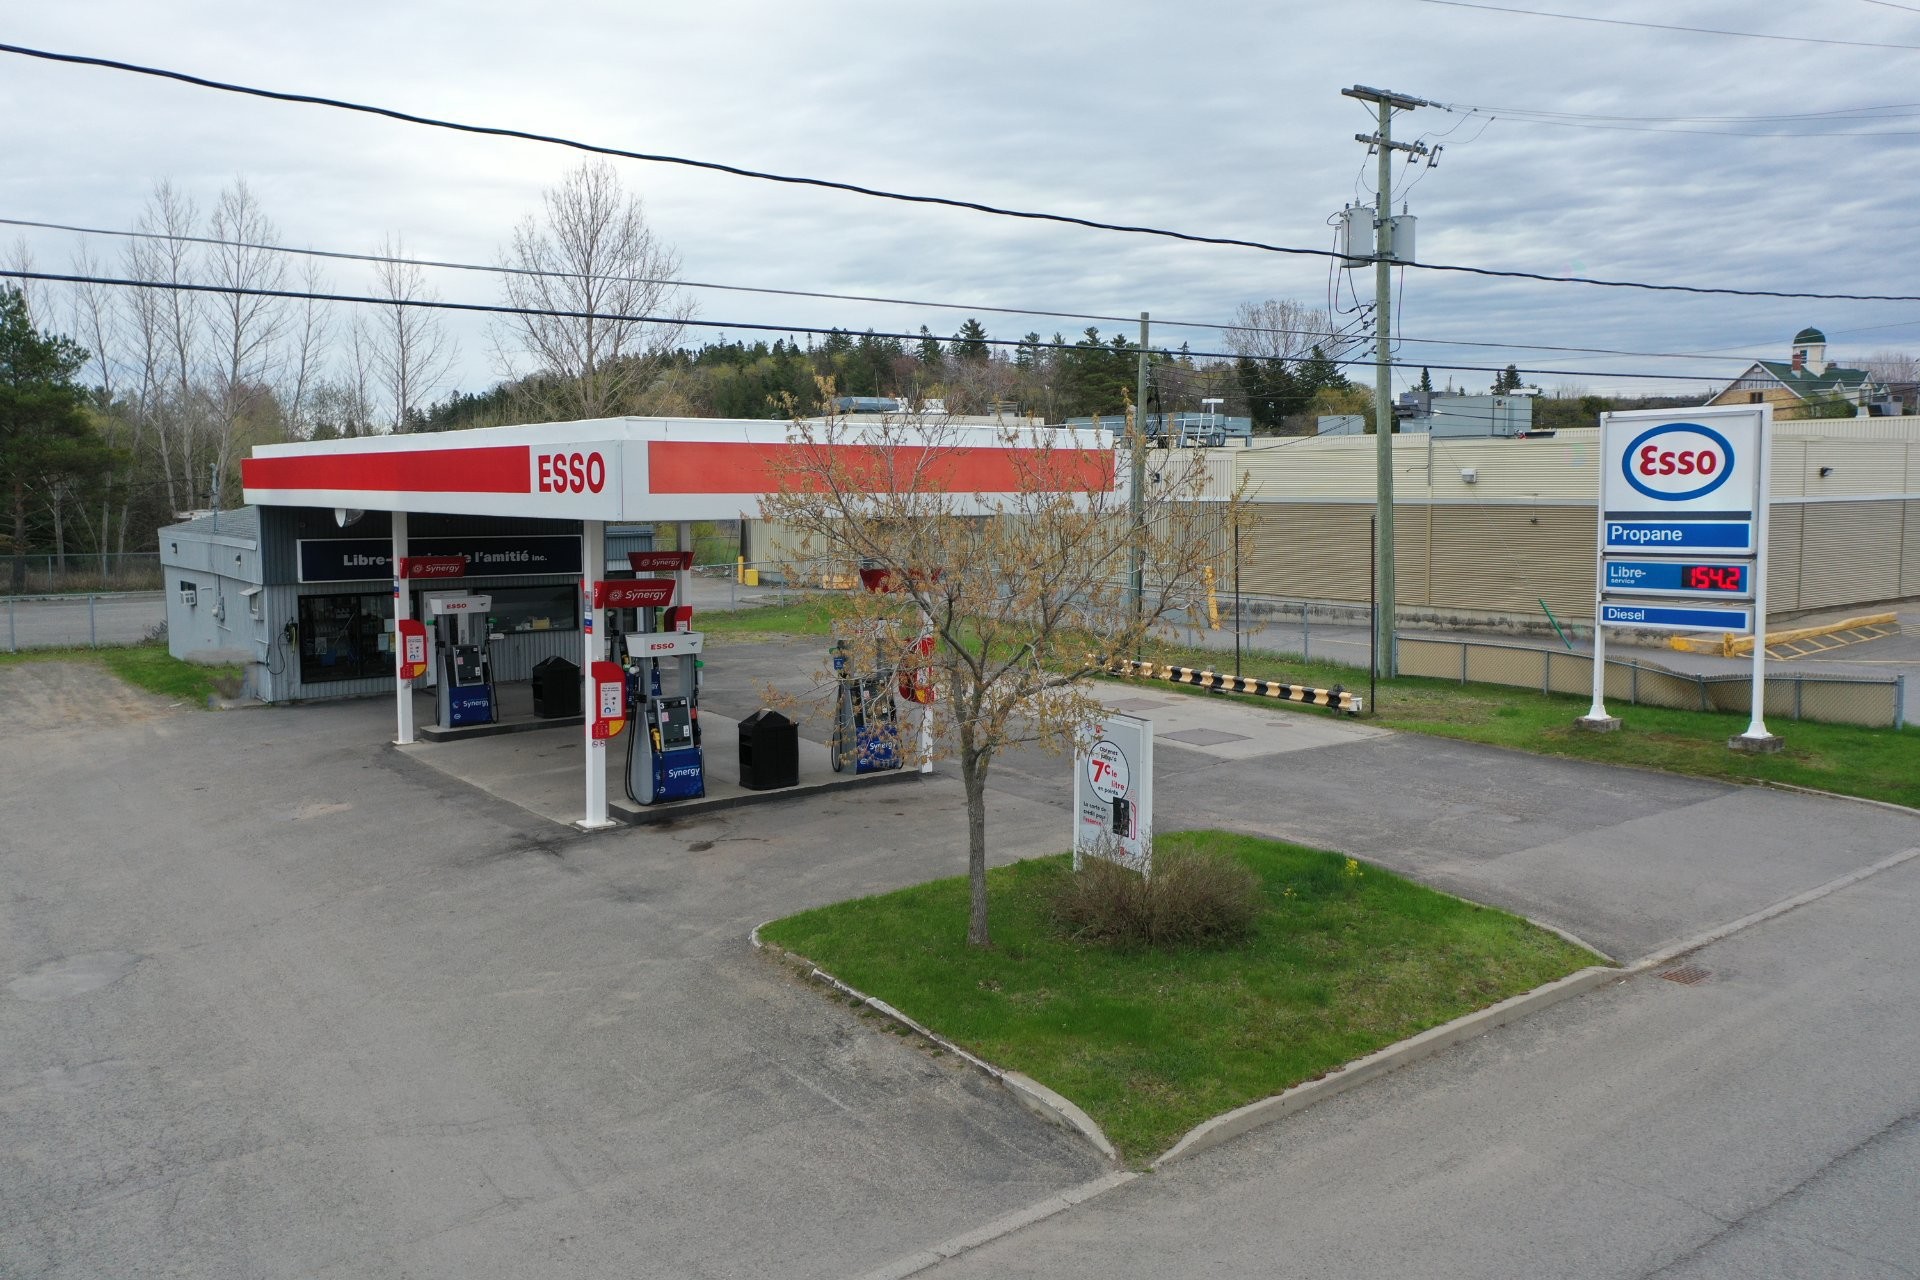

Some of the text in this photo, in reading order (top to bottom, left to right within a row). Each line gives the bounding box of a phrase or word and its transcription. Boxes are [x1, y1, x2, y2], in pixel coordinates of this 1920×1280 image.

[1639, 445, 1717, 476] Esso
[538, 451, 606, 494] ESSO
[1611, 525, 1683, 543] Propane
[475, 550, 530, 563] l'amitié
[532, 554, 547, 562] inc.
[425, 564, 460, 573] Synergy
[651, 559, 681, 567] Synergy
[1611, 566, 1647, 578] Libre-
[1690, 566, 1741, 591] 154.2
[625, 590, 667, 602] Synergy
[1608, 608, 1645, 621] Diesel
[650, 643, 675, 651] ESSO
[668, 767, 701, 780] Synergy
[1111, 769, 1118, 778] le
[1111, 780, 1125, 791] litre
